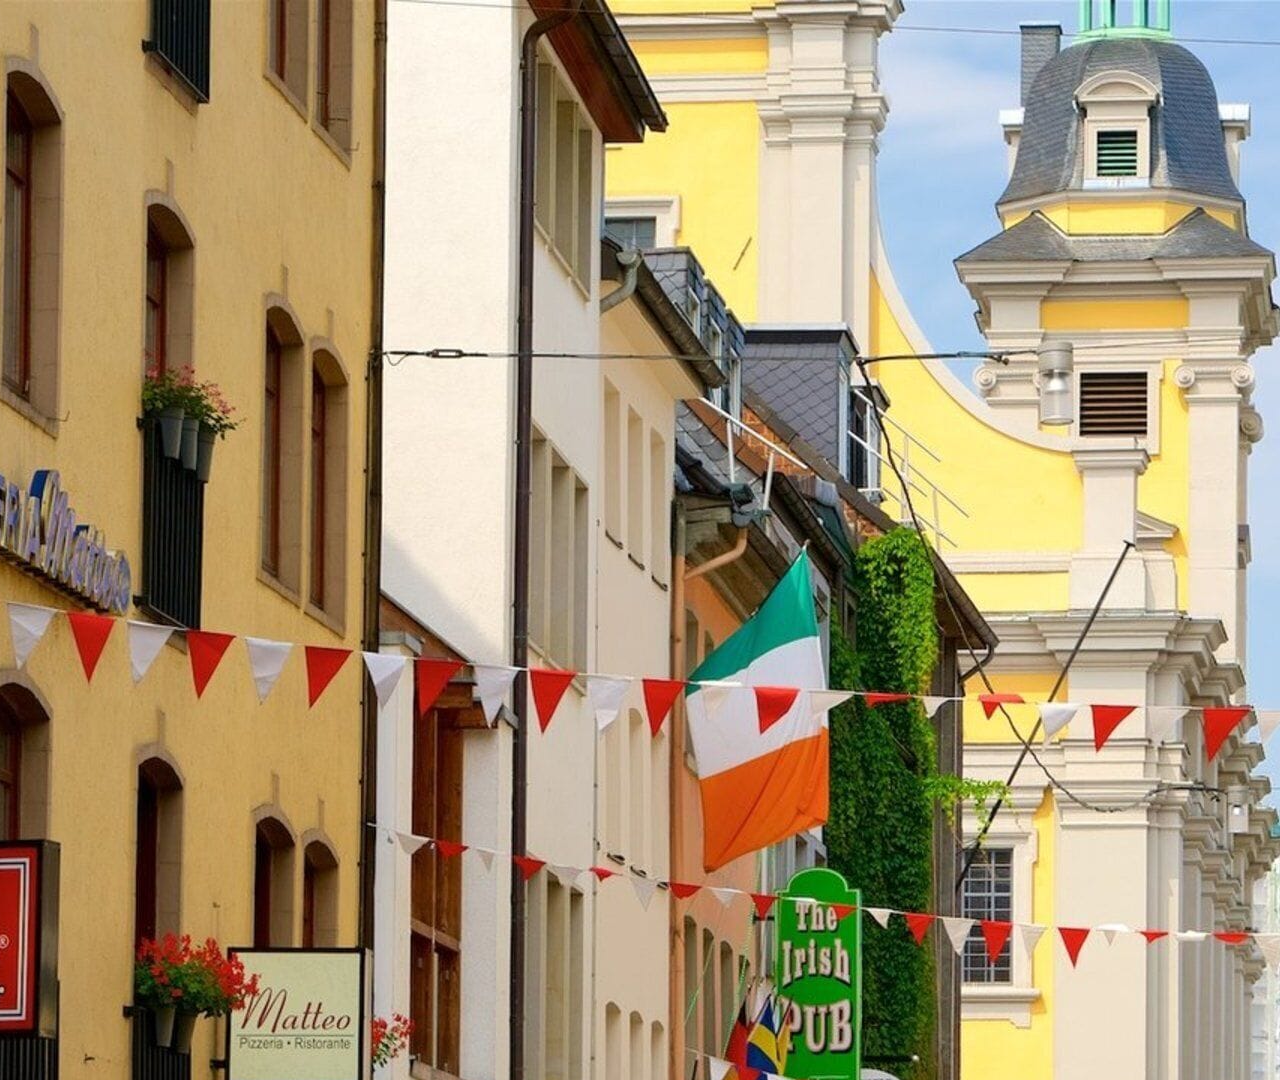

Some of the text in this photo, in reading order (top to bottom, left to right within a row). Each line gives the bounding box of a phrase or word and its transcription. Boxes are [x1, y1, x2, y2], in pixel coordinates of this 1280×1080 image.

[795, 900, 838, 931] The
[782, 939, 850, 986] Irish
[241, 986, 351, 1033] Matteo
[780, 999, 852, 1052] PUB
[239, 1037, 351, 1049] Pizzeria Ristorante
